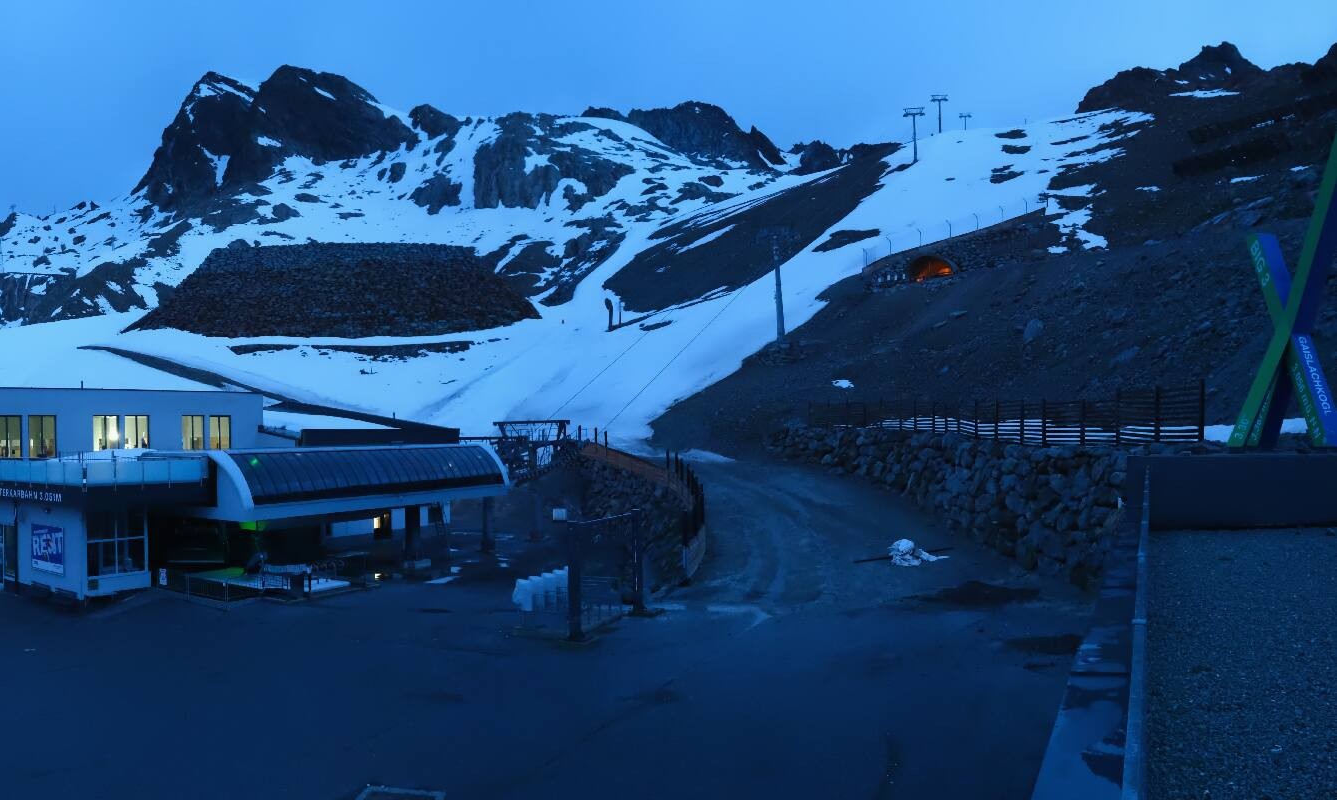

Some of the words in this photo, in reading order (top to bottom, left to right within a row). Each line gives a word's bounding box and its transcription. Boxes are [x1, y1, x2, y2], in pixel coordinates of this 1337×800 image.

[1250, 240, 1265, 273] BIG
[1297, 336, 1333, 416] GAISLACHKOGL
[32, 532, 63, 556] RENT
